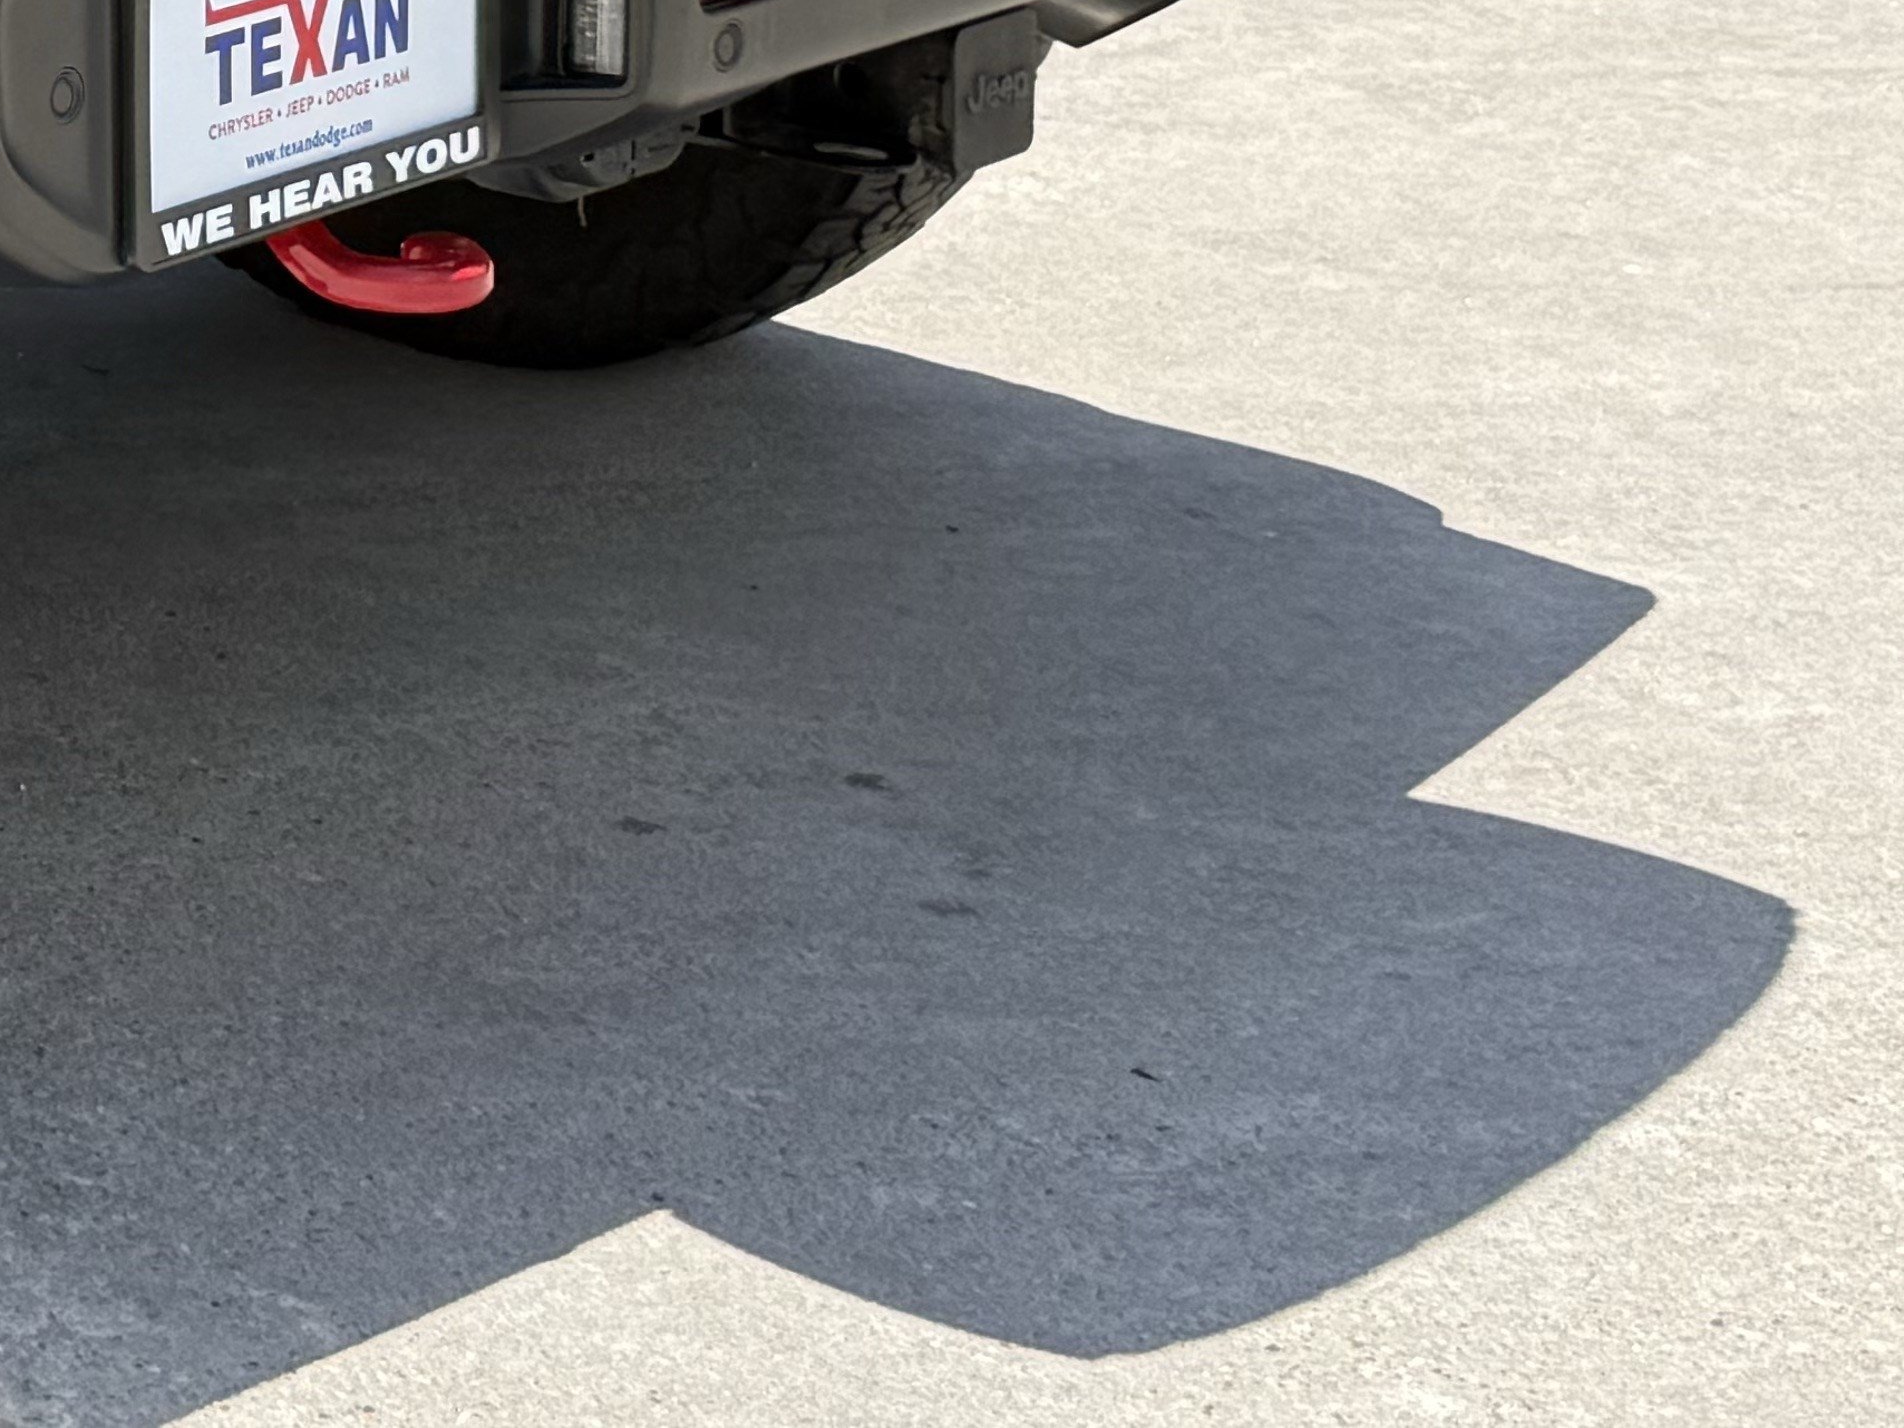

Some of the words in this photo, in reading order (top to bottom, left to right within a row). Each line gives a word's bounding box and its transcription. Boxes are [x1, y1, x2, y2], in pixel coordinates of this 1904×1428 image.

[208, 108, 274, 141] CHRYSLER
[286, 95, 315, 119] JEEP
[326, 78, 371, 106] DODGE
[382, 66, 410, 89] RAM
[965, 71, 1030, 114] Jeep
[245, 118, 373, 170] www.texandodge.com
[160, 203, 235, 257] WE
[248, 160, 374, 230] HEAR
[385, 125, 481, 184] YOU
